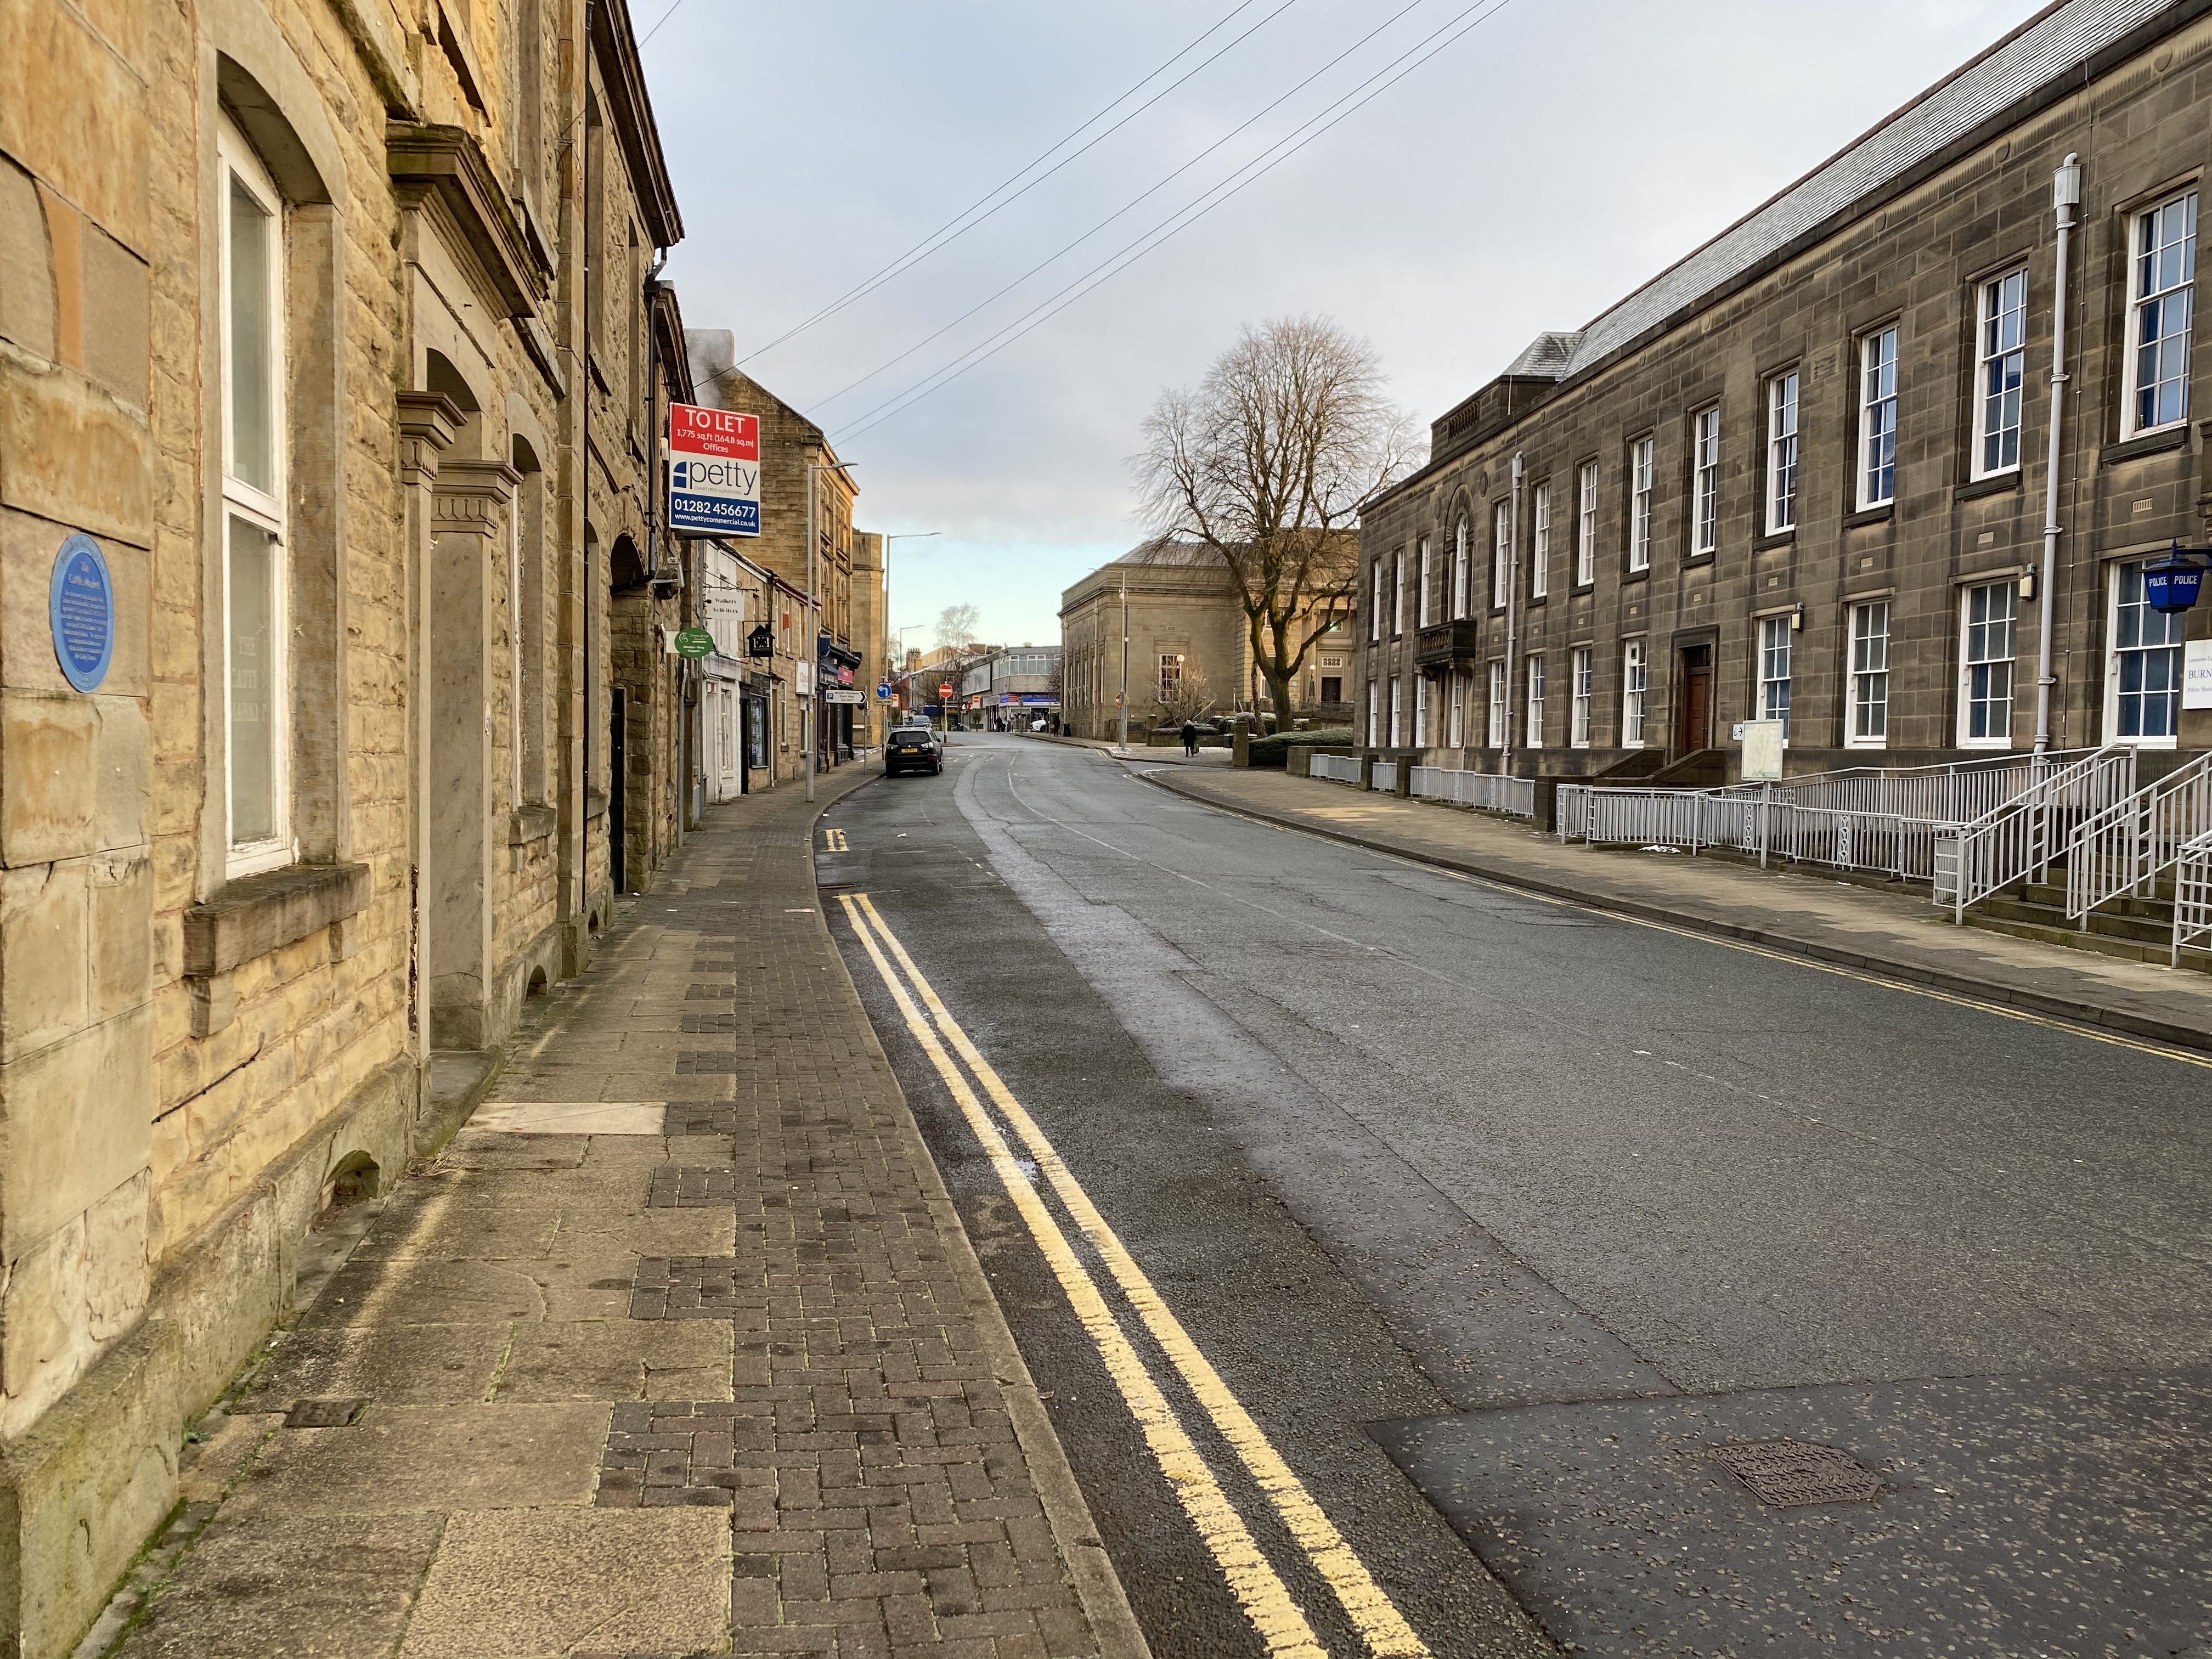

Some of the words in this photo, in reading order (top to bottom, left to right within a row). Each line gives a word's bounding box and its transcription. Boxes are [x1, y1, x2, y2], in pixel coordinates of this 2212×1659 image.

[685, 409, 710, 428] TO
[715, 414, 745, 433] LET
[676, 428, 695, 438] 1,775
[697, 432, 713, 442] sq.ft
[714, 433, 735, 444] (164.8
[736, 438, 754, 448] sq.m)
[703, 442, 729, 453] Offices
[690, 461, 757, 495] petty
[674, 499, 710, 514] 01282
[713, 503, 755, 518] 456677
[675, 514, 756, 527] www.pettycommercial.co.uk
[2149, 577, 2167, 587] POLICE
[2174, 575, 2198, 584] POLICE
